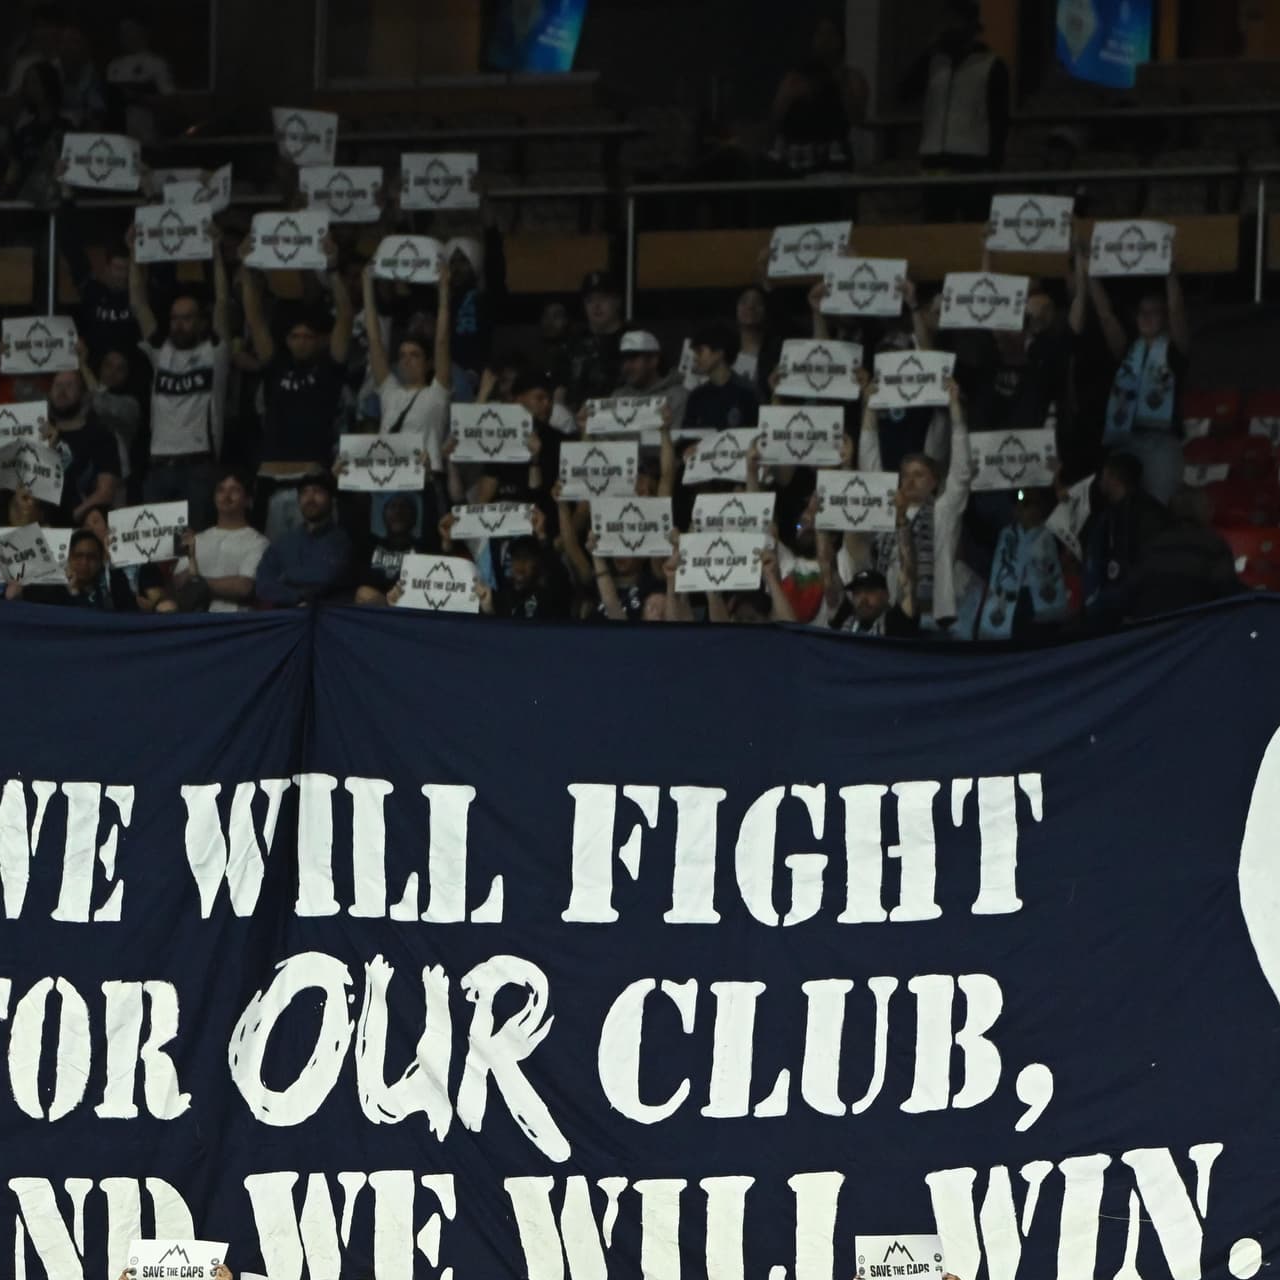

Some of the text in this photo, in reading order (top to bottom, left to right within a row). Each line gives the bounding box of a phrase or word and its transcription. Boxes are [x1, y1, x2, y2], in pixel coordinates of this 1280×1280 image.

[159, 374, 204, 392] TELUS
[181, 773, 503, 923] WILL
[562, 773, 1042, 926] FIGHT
[229, 952, 571, 1162] OUR
[598, 974, 1053, 1131] CLUB,
[143, 1266, 203, 1278] SAVE THE CAPS
